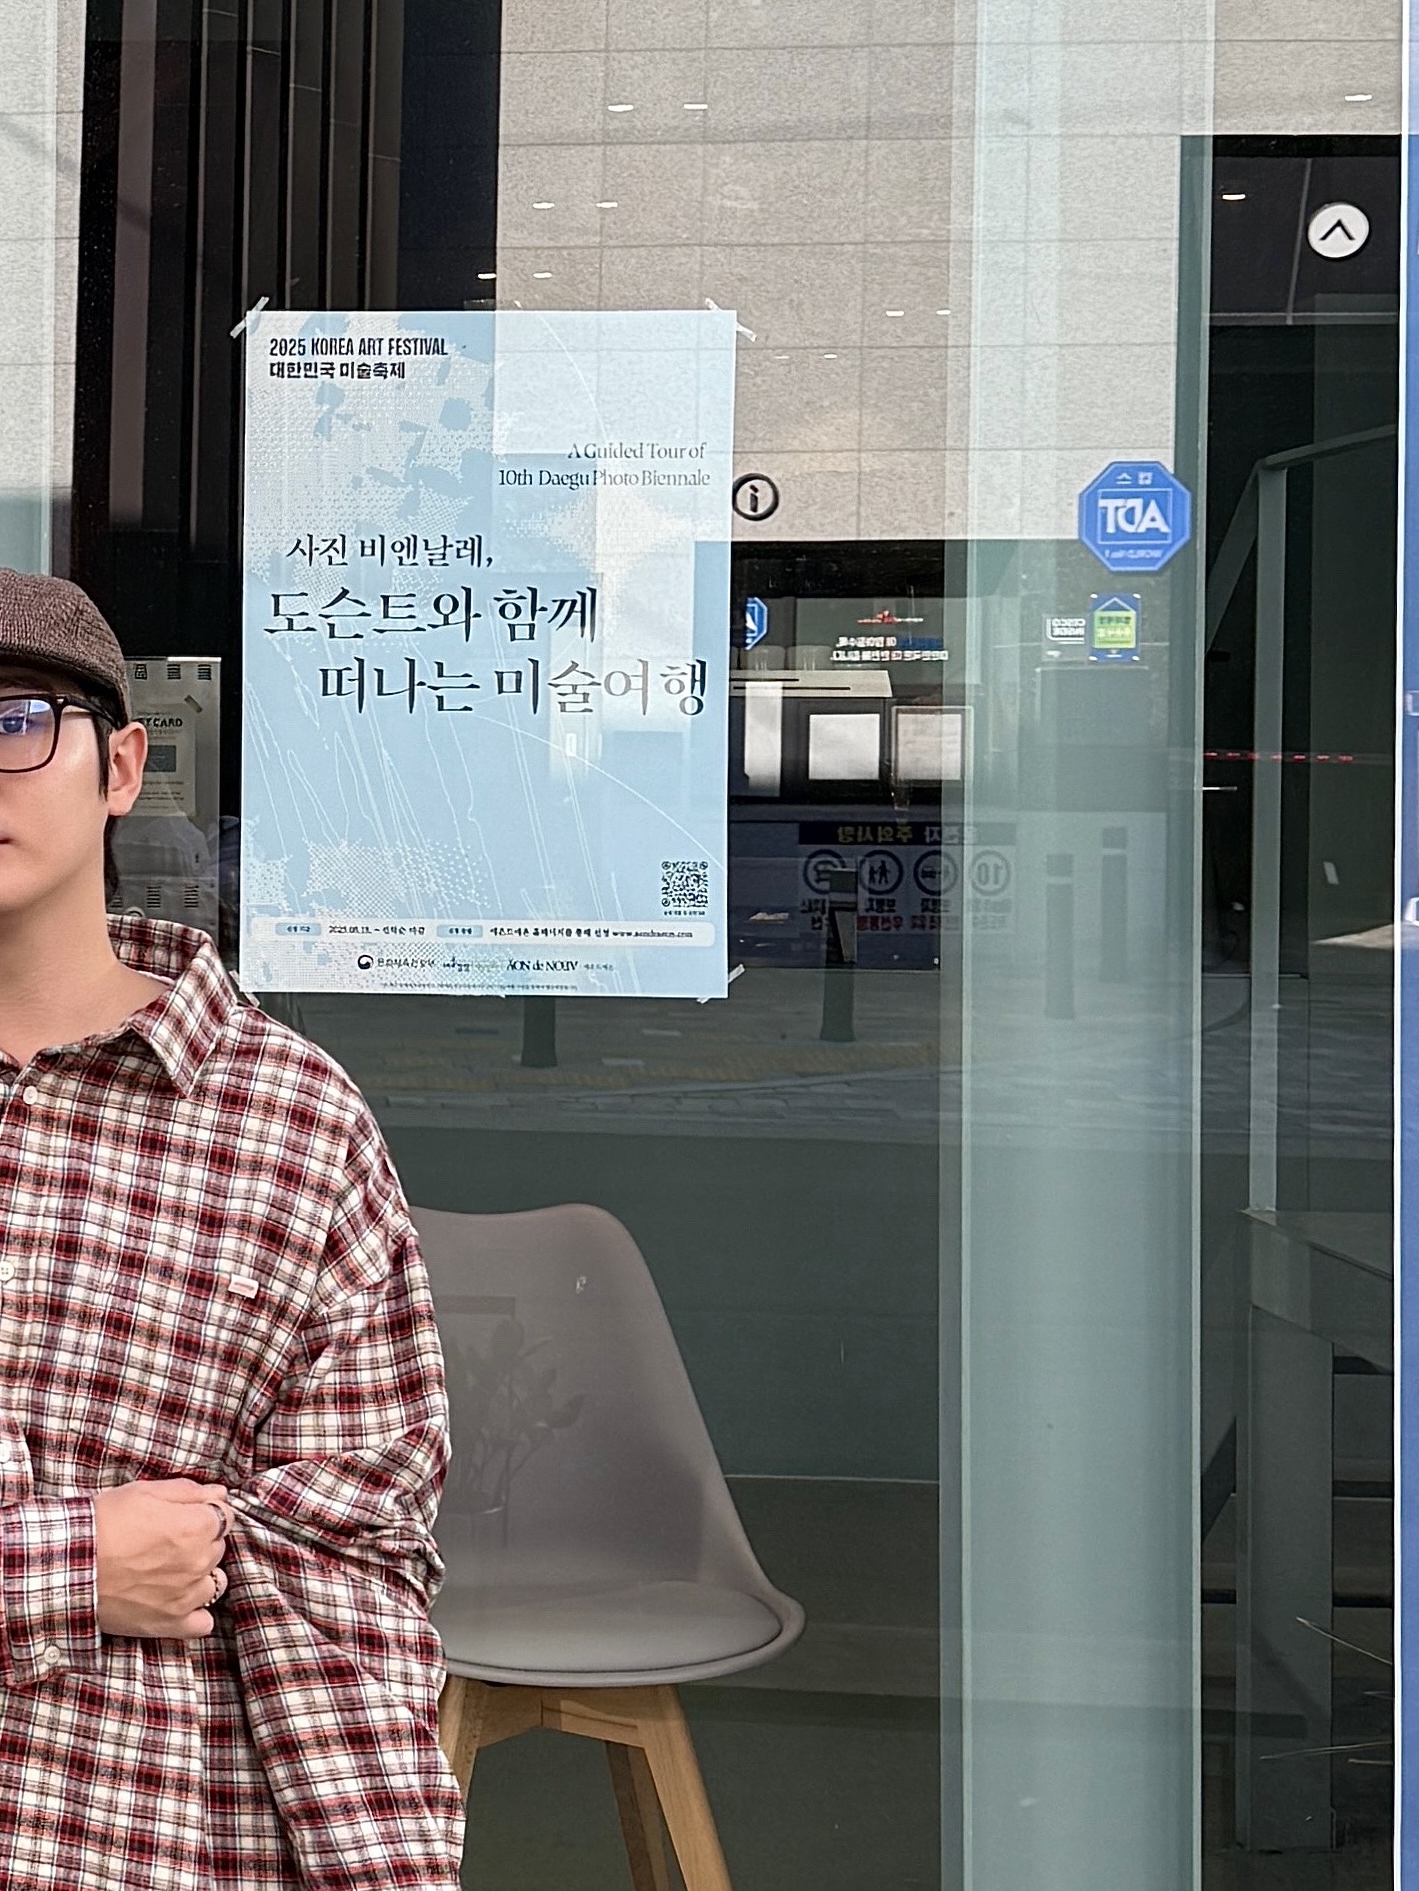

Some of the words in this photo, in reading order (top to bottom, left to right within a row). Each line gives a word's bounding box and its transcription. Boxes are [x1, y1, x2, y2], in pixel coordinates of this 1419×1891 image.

[269, 337, 306, 356] 2025
[311, 337, 354, 356] KOREA
[358, 337, 383, 356] ART
[388, 337, 449, 356] FESTIVAL
[269, 361, 336, 379] 대한민국
[339, 361, 406, 380] 미술축제
[567, 442, 581, 459] A
[584, 442, 644, 459] Guided
[646, 442, 686, 459] Tour
[688, 441, 708, 459] of
[498, 469, 533, 486] 10th
[538, 469, 590, 491] Daegu
[593, 469, 639, 487] Photo
[641, 469, 711, 487] Biennale
[286, 533, 348, 568] 사진
[359, 533, 494, 569] 비엔날레,
[263, 586, 482, 643] 도슨트와
[493, 586, 597, 643] 함께
[319, 656, 481, 715] 떠나는
[494, 657, 708, 716] 미술여행
